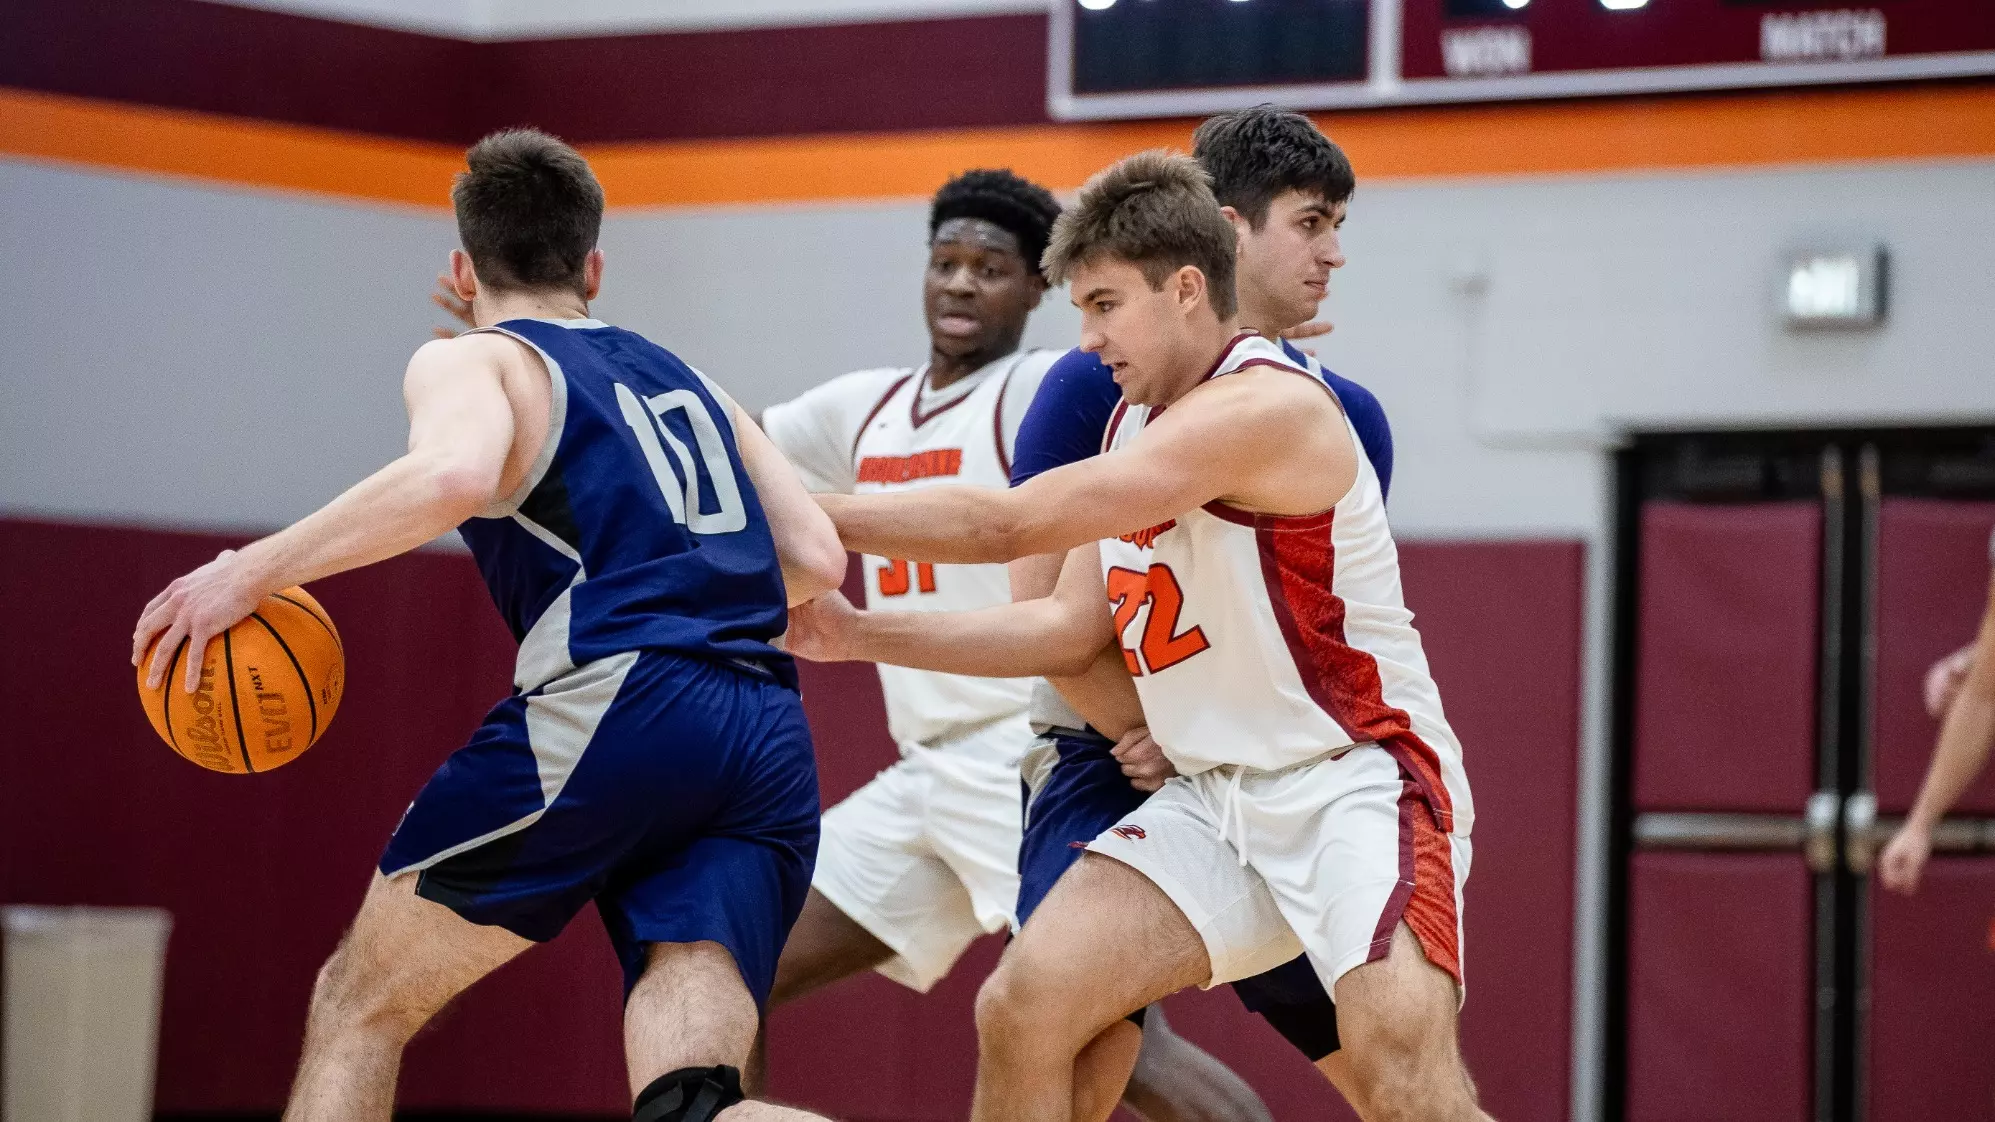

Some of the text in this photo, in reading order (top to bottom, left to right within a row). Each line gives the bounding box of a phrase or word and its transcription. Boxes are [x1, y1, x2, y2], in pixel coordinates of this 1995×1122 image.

[614, 382, 747, 535] 10
[1107, 562, 1211, 677] 22
[248, 665, 264, 691] NXT
